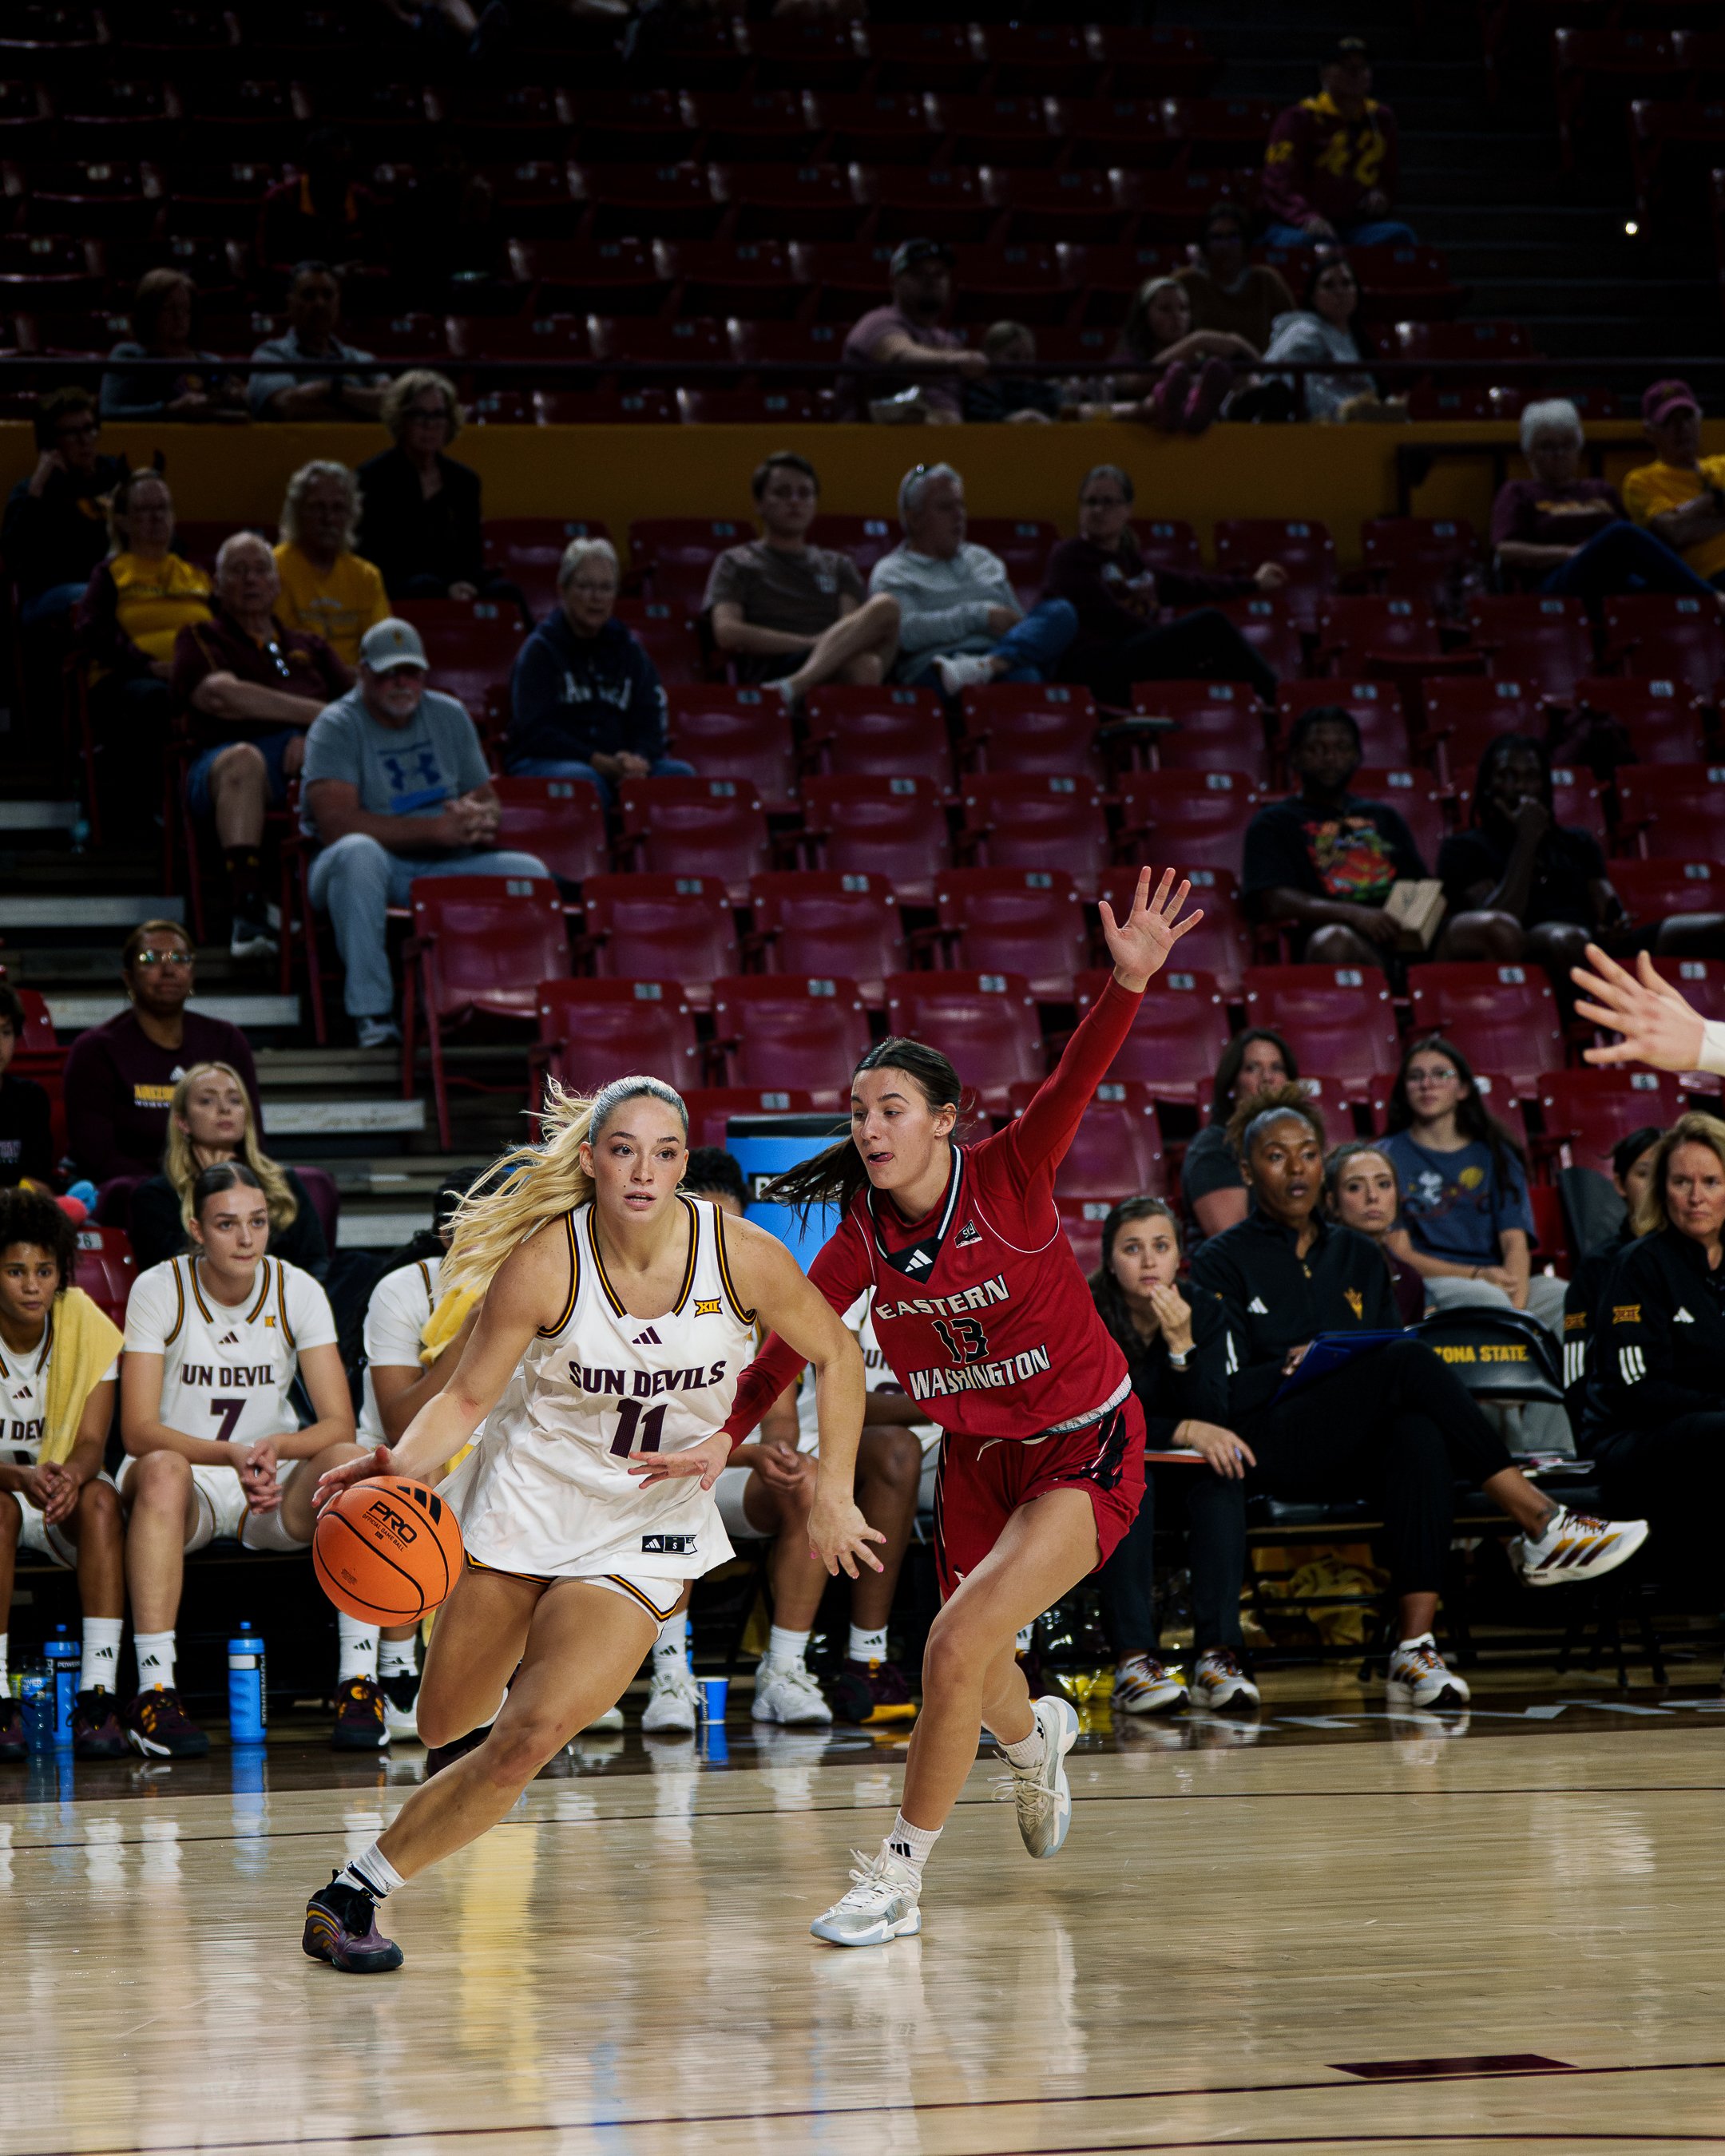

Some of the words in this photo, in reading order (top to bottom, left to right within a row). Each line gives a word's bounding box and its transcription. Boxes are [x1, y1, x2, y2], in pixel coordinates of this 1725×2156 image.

[694, 1298, 722, 1316] XII
[875, 1273, 1010, 1320] EASTERN
[931, 1318, 989, 1364] 13
[1479, 1345, 1529, 1362] STATE
[180, 1364, 213, 1387] UN
[219, 1365, 275, 1388] DEVIL
[568, 1361, 626, 1397] SUN
[631, 1360, 727, 1399] DEVILS
[908, 1344, 1051, 1401] WASHINGTON
[11, 1417, 46, 1441] DEV
[210, 1399, 247, 1442] 7
[609, 1398, 668, 1459] 11
[362, 1513, 381, 1530] OFFICIAL
[380, 1528, 395, 1541] GAME
[392, 1539, 404, 1552] BALL
[368, 1500, 417, 1544] PRO
